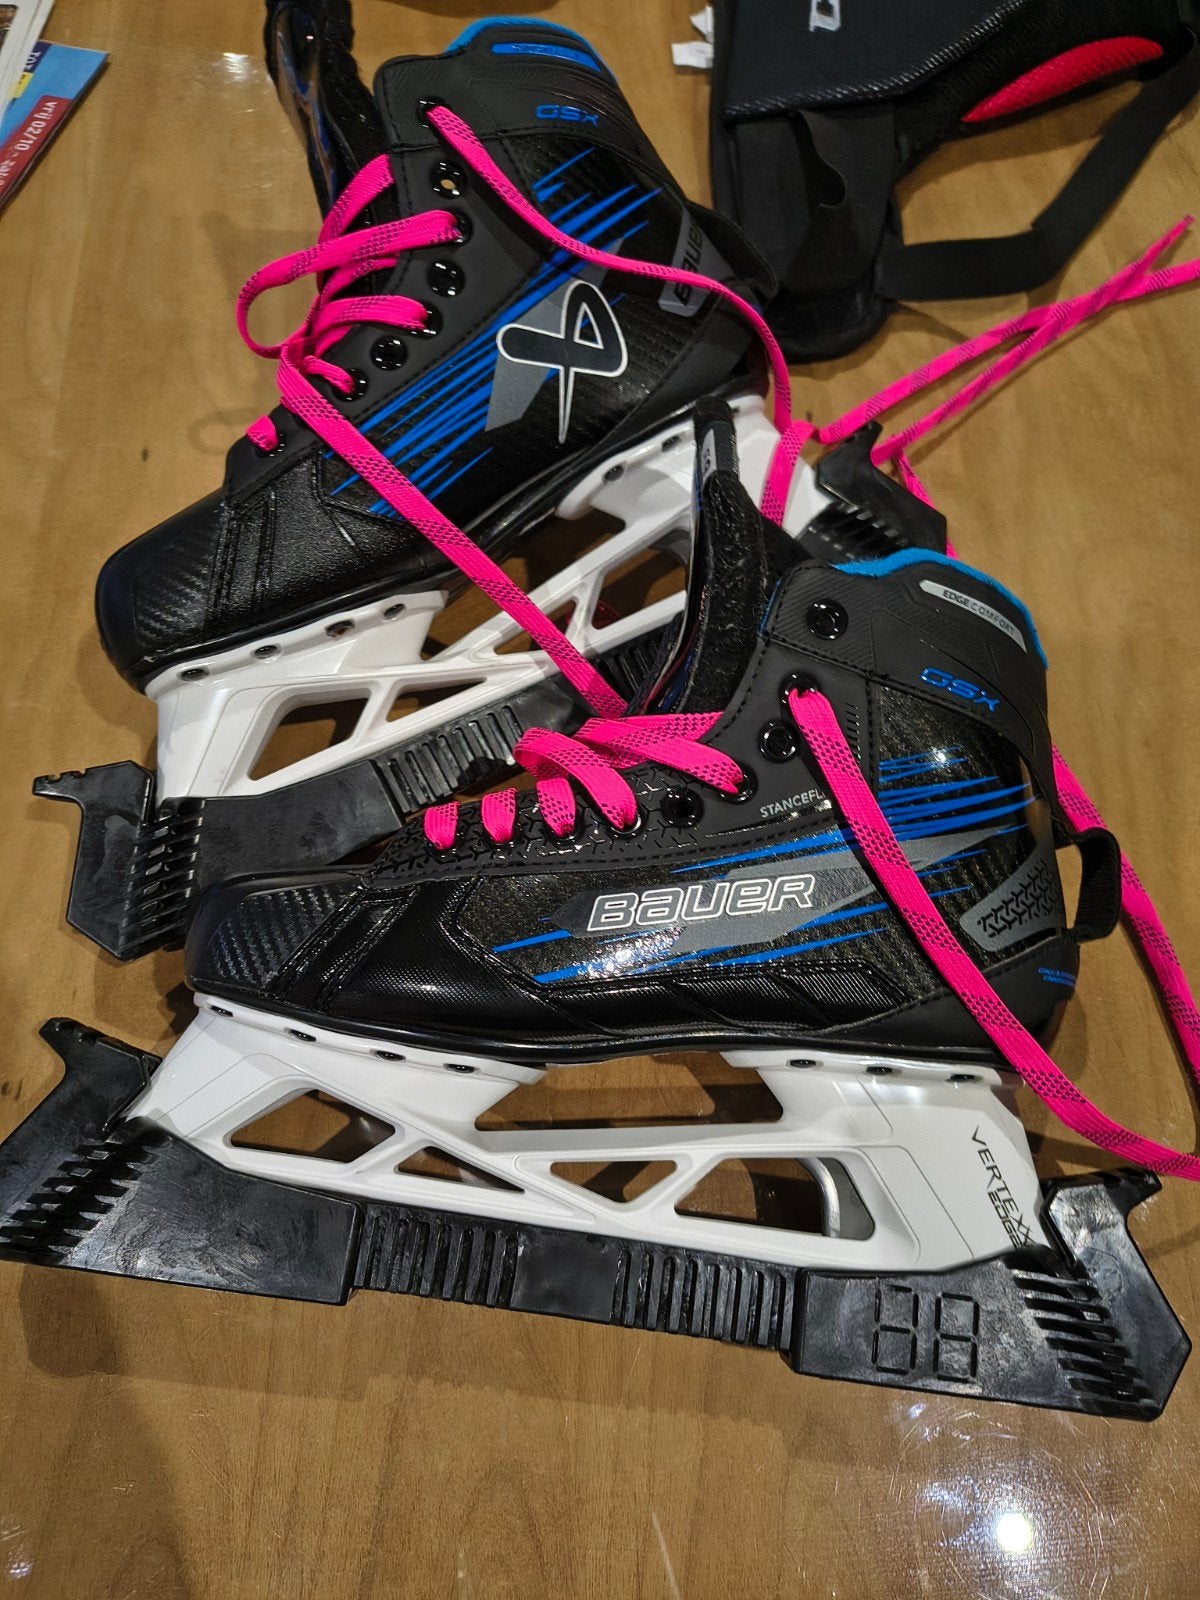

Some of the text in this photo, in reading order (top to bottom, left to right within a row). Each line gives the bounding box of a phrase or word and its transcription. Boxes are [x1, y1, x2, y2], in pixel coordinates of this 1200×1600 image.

[33, 101, 58, 119] vrij
[15, 120, 47, 150] 02/10
[920, 667, 1000, 713] GSX
[760, 788, 826, 818] STANCEFL
